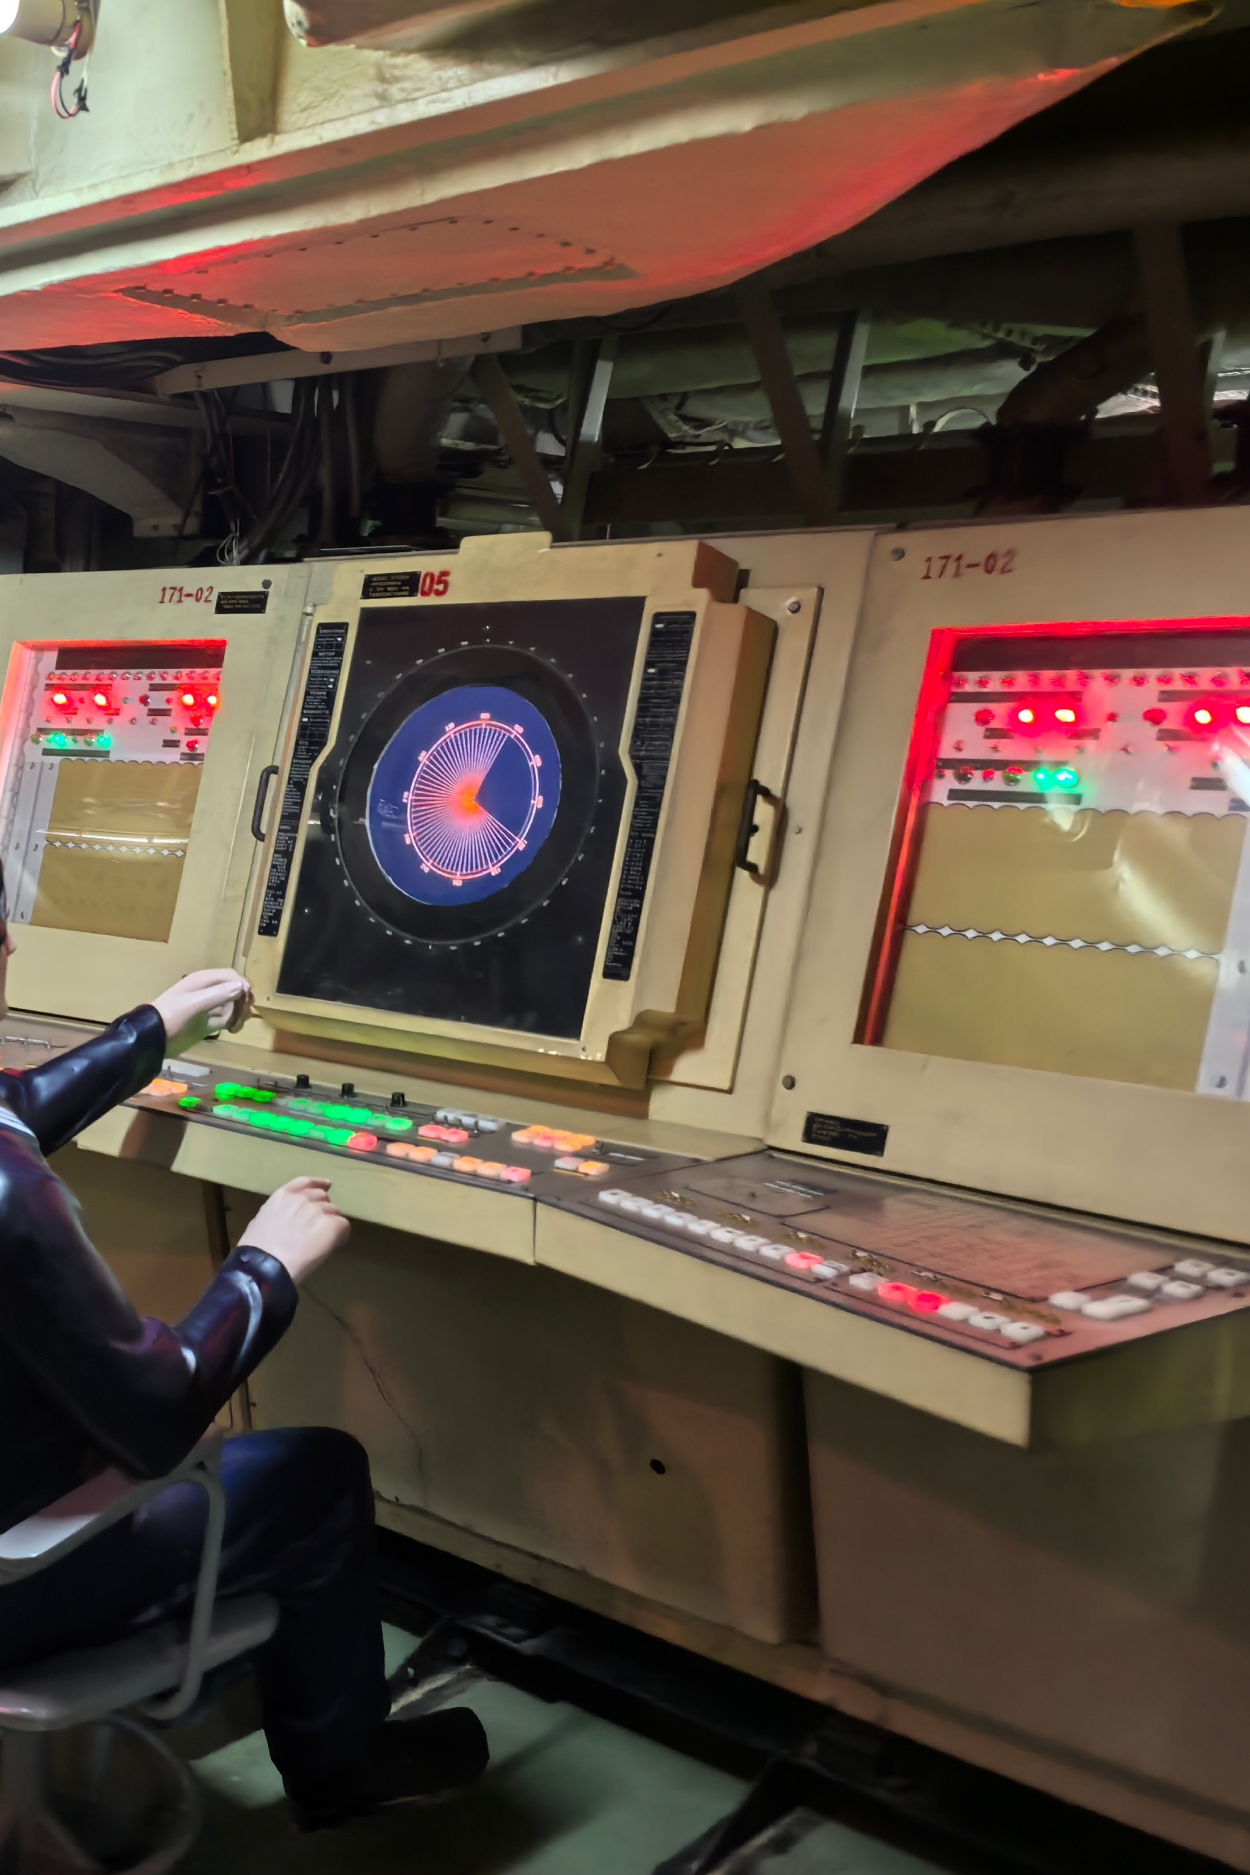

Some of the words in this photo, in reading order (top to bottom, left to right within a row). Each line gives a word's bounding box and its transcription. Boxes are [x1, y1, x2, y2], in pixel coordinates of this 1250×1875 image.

[920, 548, 1017, 579] 171-02
[159, 586, 214, 604] 171-02
[419, 571, 451, 597] 05
